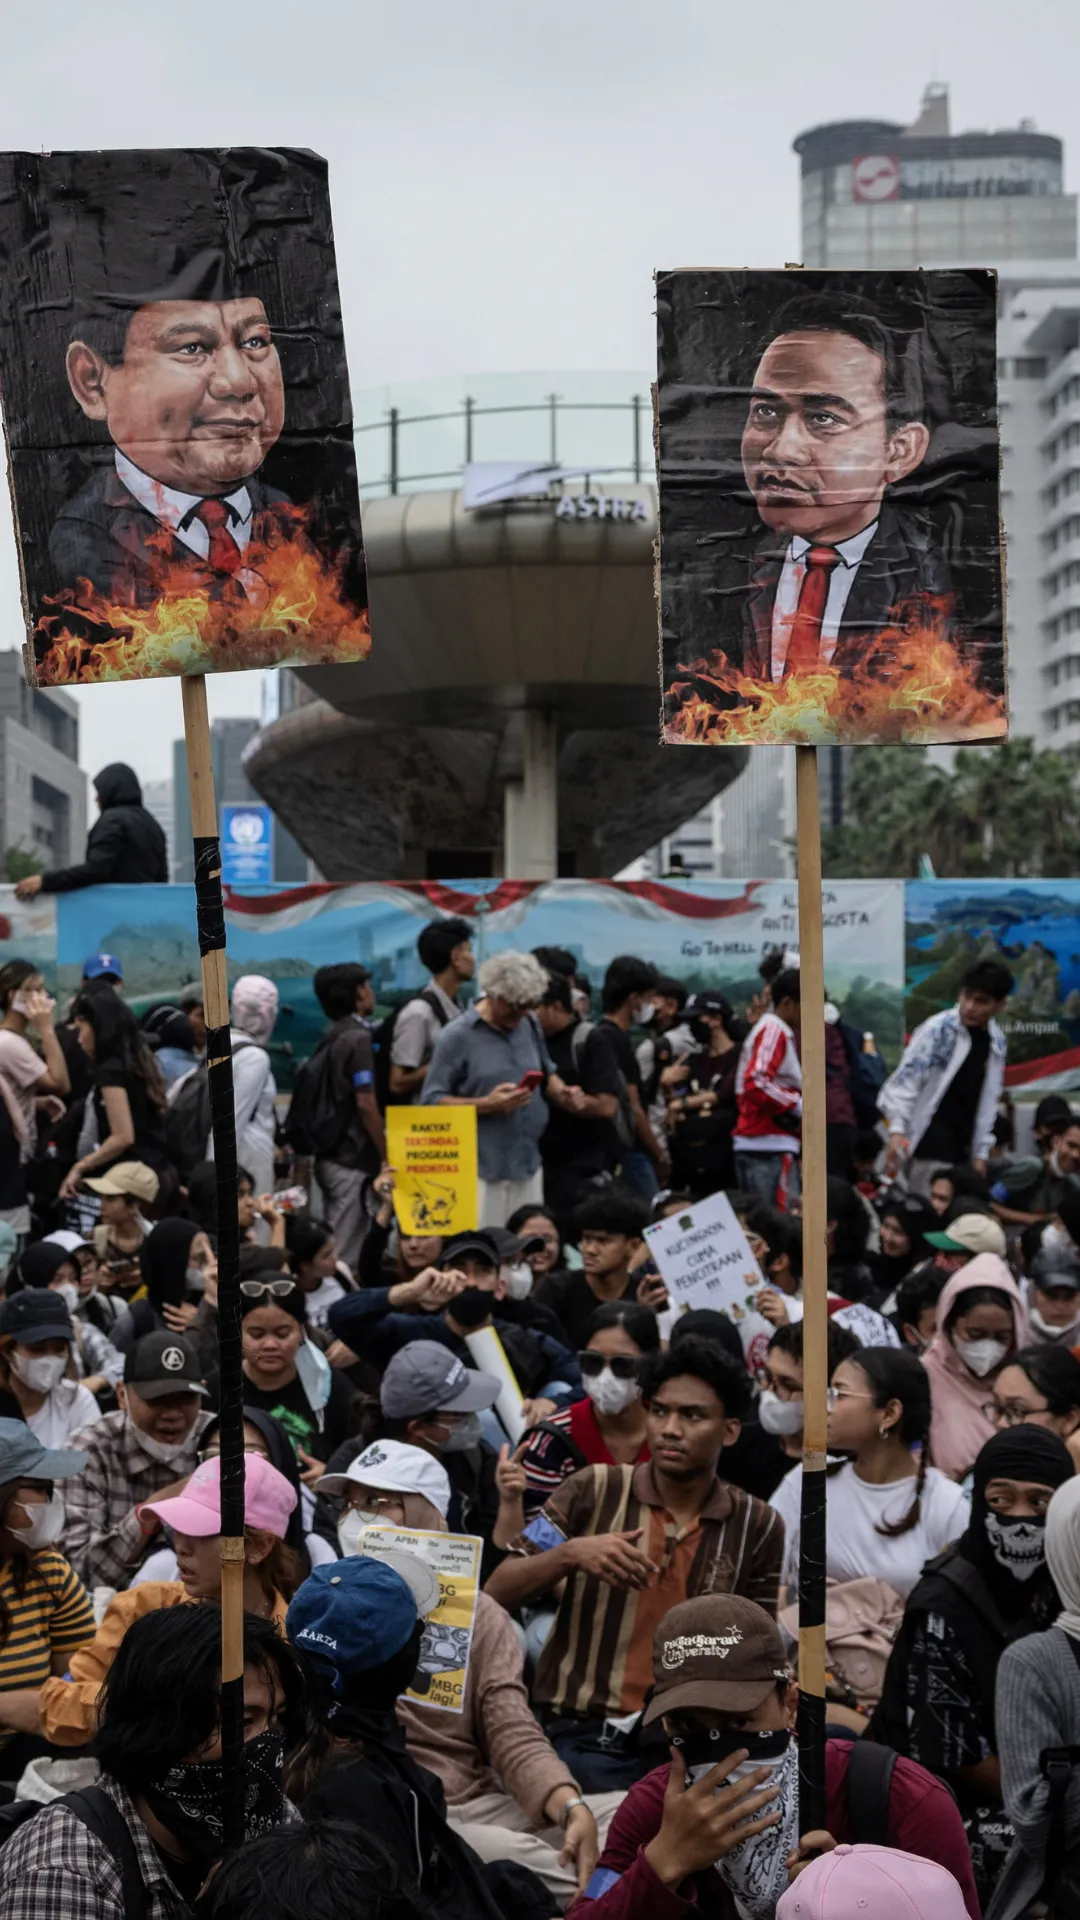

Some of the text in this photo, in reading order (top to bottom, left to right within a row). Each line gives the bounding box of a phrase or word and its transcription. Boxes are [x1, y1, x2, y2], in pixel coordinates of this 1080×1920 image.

[556, 495, 649, 522] ASTRA
[411, 1122, 451, 1133] RAKYAT
[405, 1150, 460, 1161] PROGRAM
[406, 1163, 460, 1174] PRIORITAS
[428, 1539, 440, 1548] itu
[449, 1542, 474, 1552] untuk
[438, 1583, 456, 1597] BG
[667, 1646, 730, 1662] University
[432, 1678, 463, 1695] MBG
[429, 1690, 454, 1706] lagi
